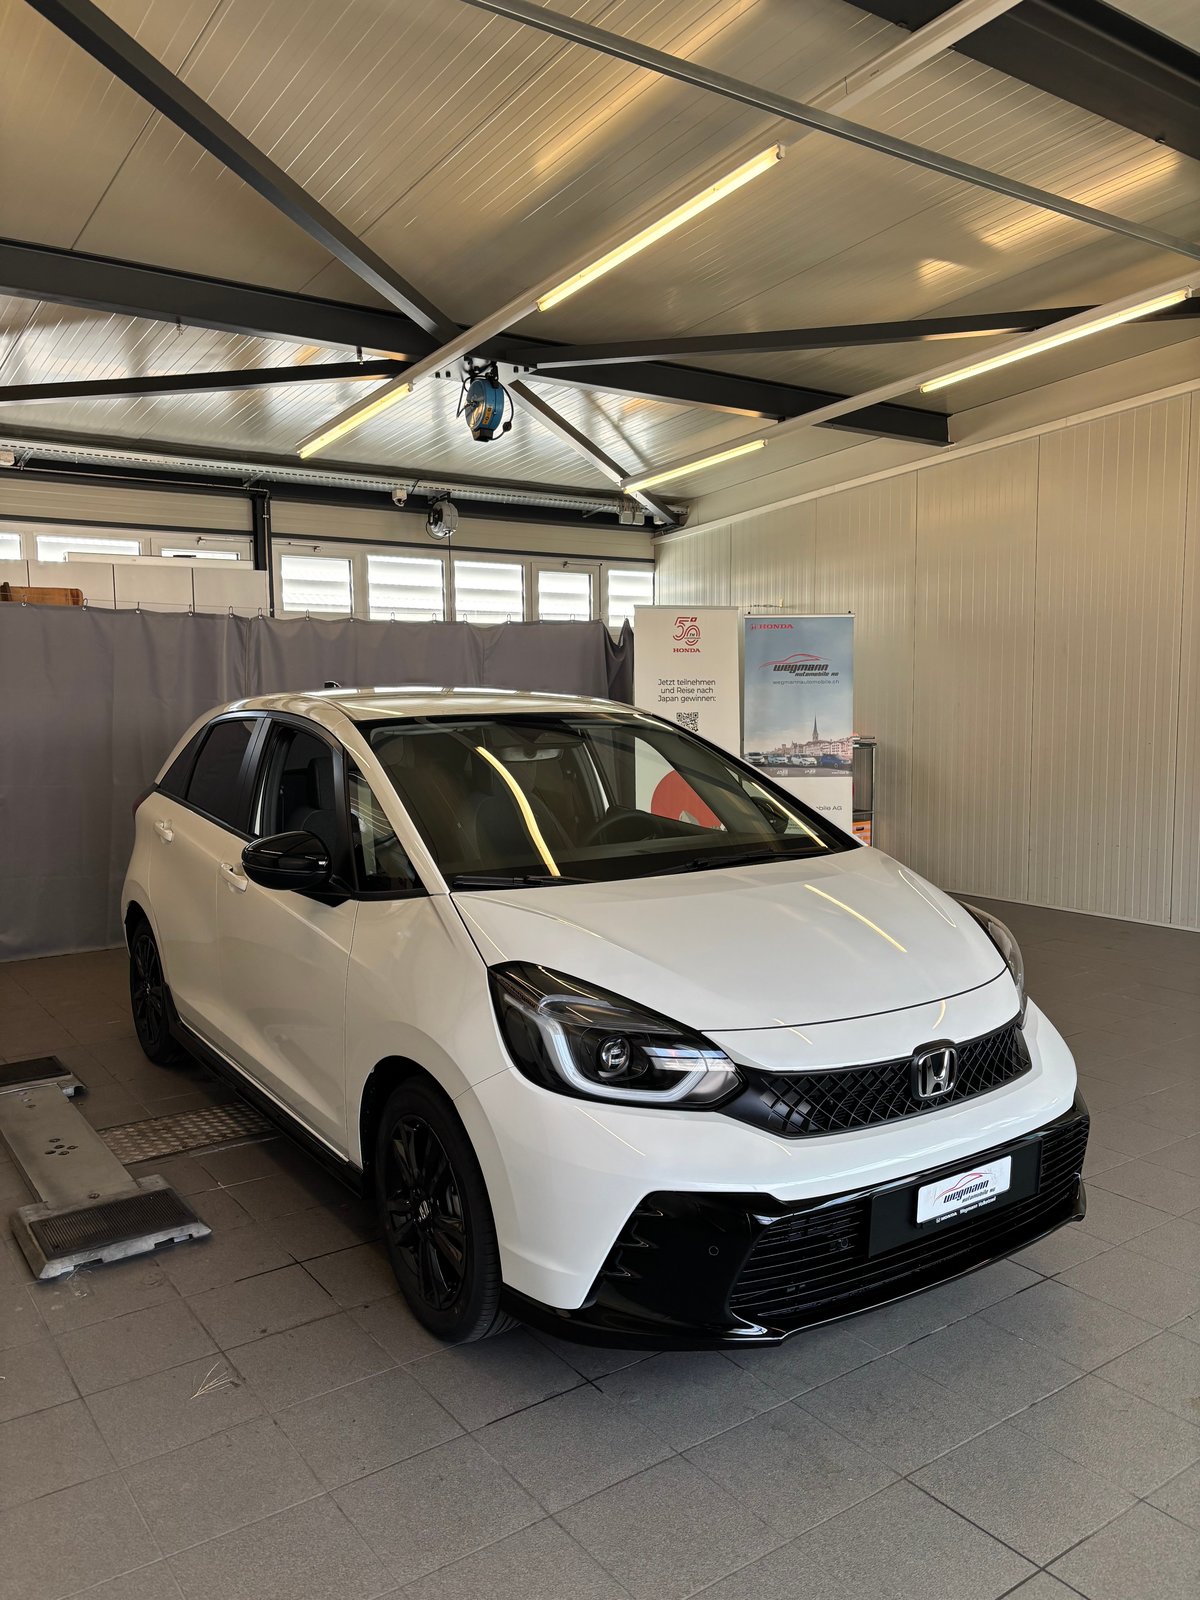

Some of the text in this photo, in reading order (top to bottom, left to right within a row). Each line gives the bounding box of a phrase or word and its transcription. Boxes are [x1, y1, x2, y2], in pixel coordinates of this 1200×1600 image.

[773, 663, 829, 673] wegmann
[658, 695, 679, 703] Japan
[943, 1180, 989, 1203] wegmann
